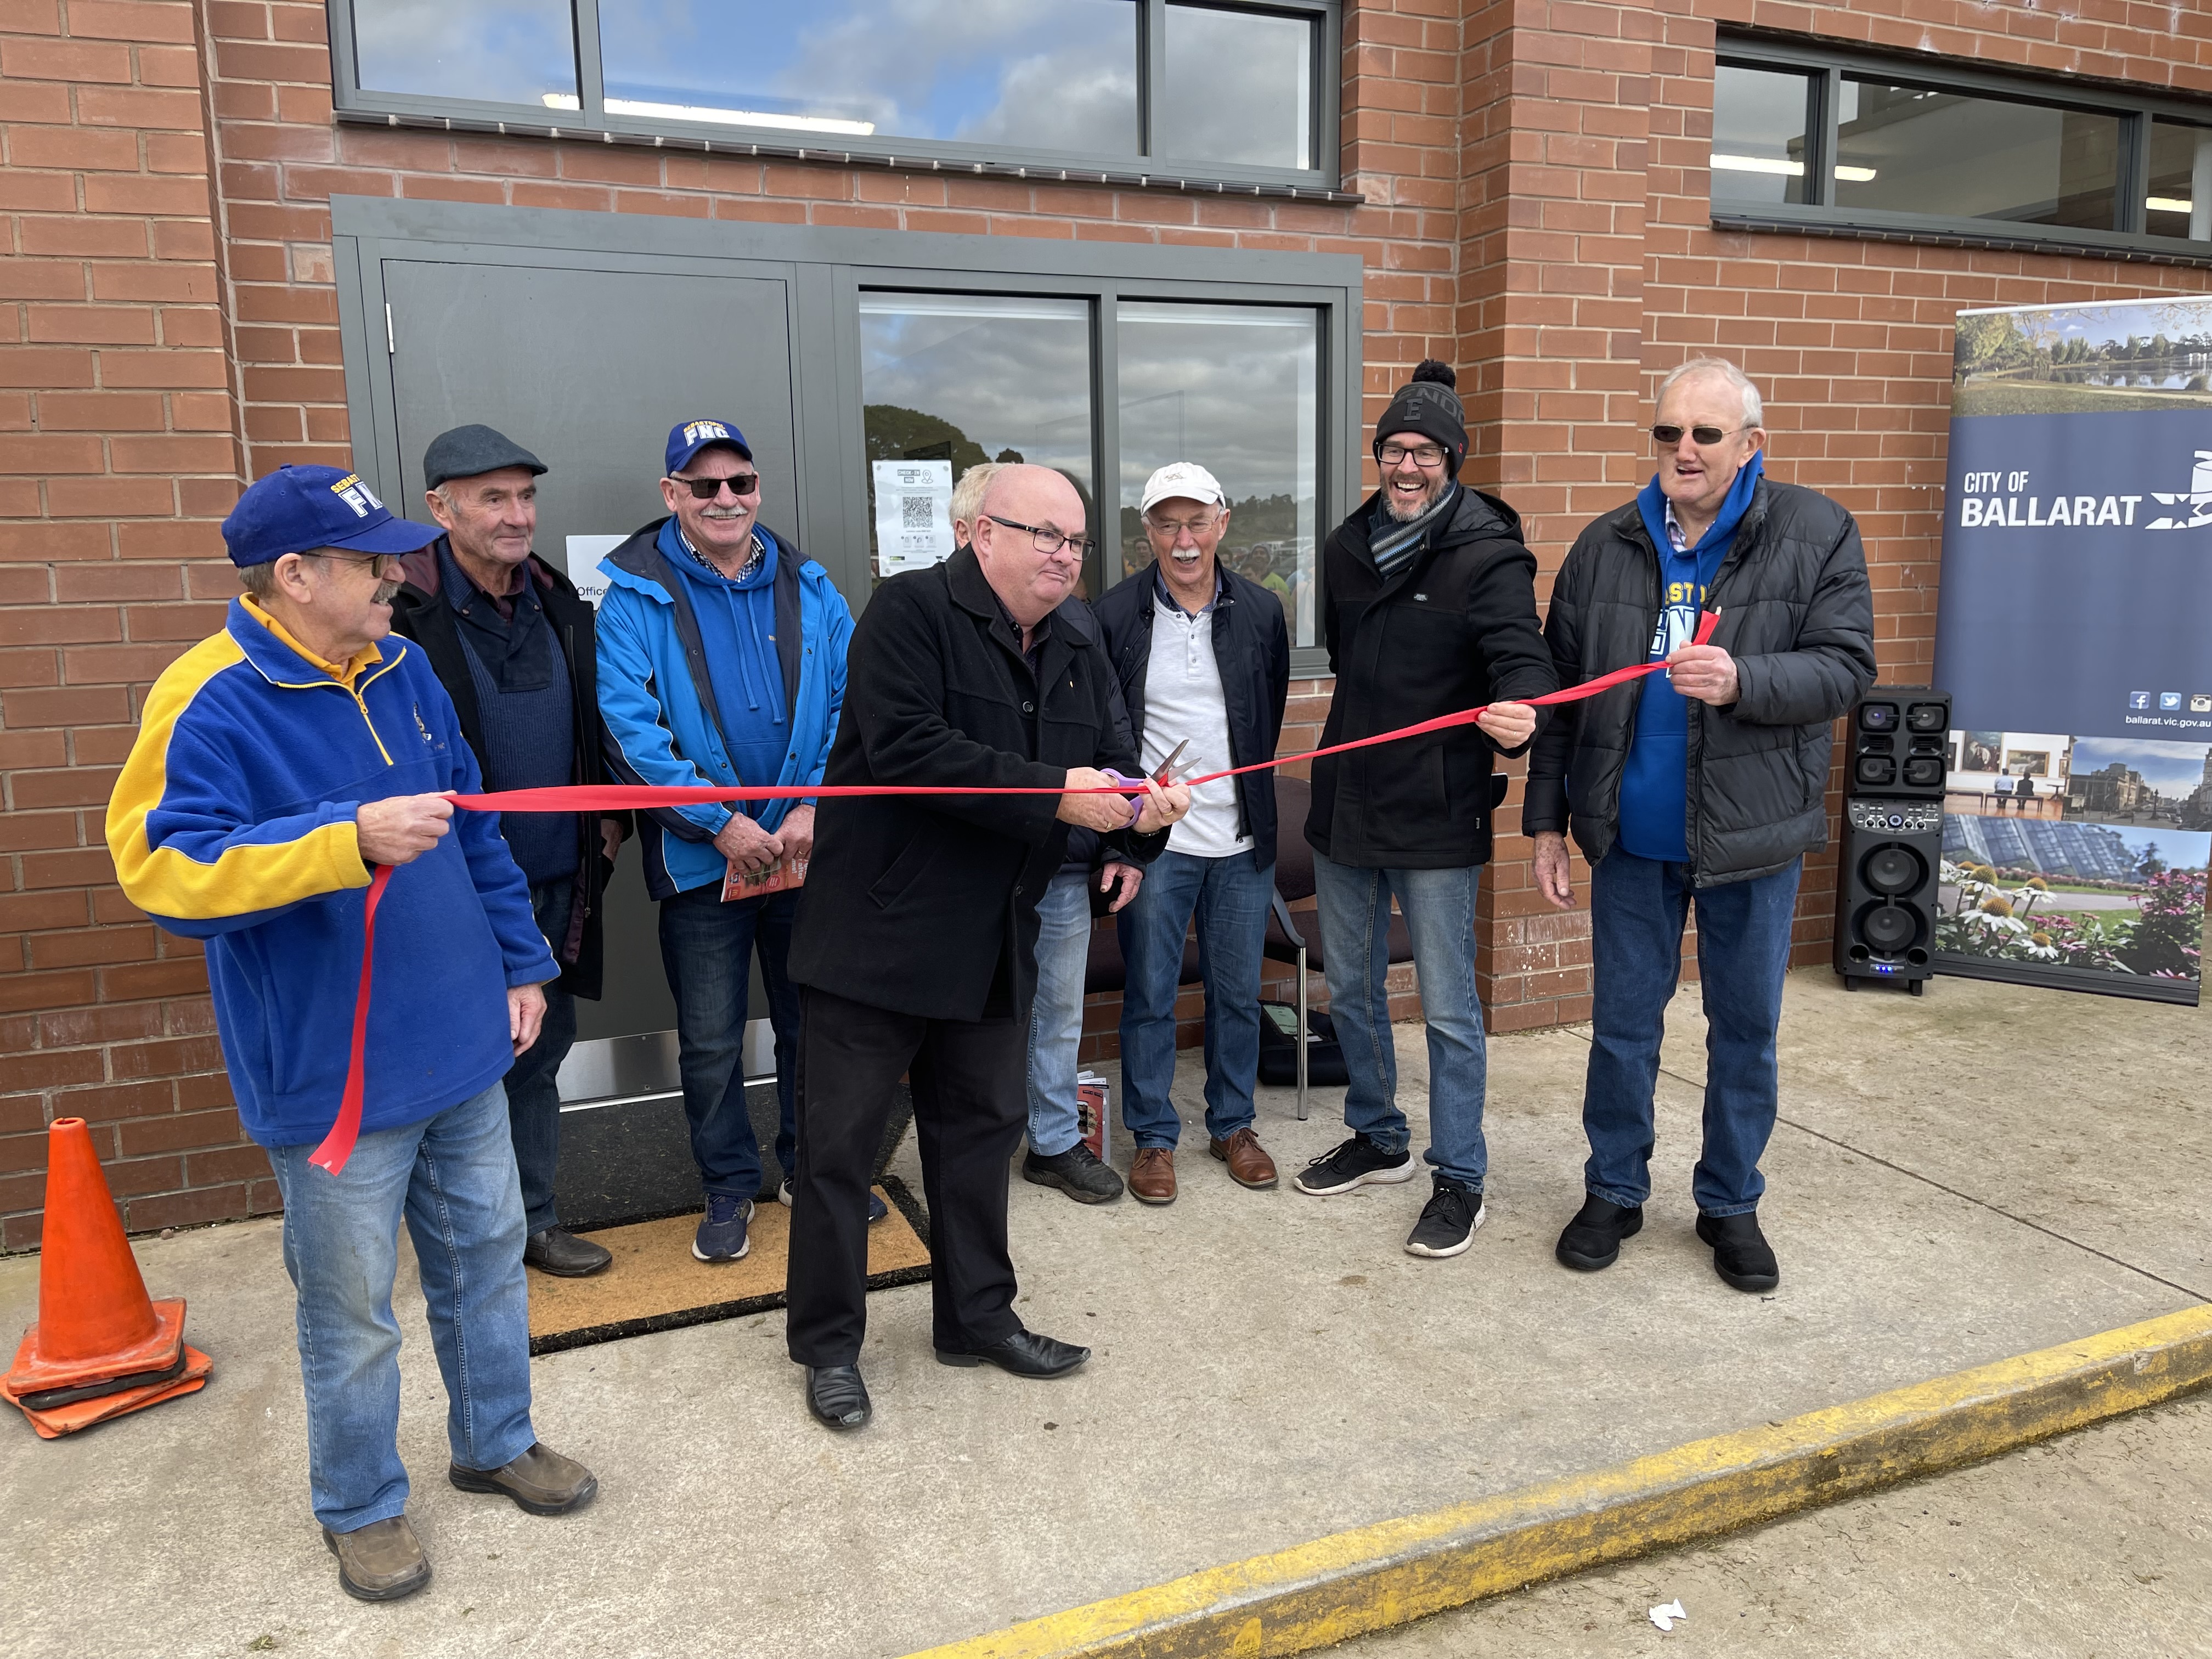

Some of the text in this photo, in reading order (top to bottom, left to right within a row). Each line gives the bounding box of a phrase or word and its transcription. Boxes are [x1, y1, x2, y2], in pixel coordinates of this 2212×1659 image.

[1403, 398, 1423, 421] E
[684, 424, 730, 447] FNC
[1963, 471, 2029, 493] CITY OF
[1961, 495, 2142, 527] BALLARAT
[2125, 715, 2212, 729] ballarat.vic.gov.au
